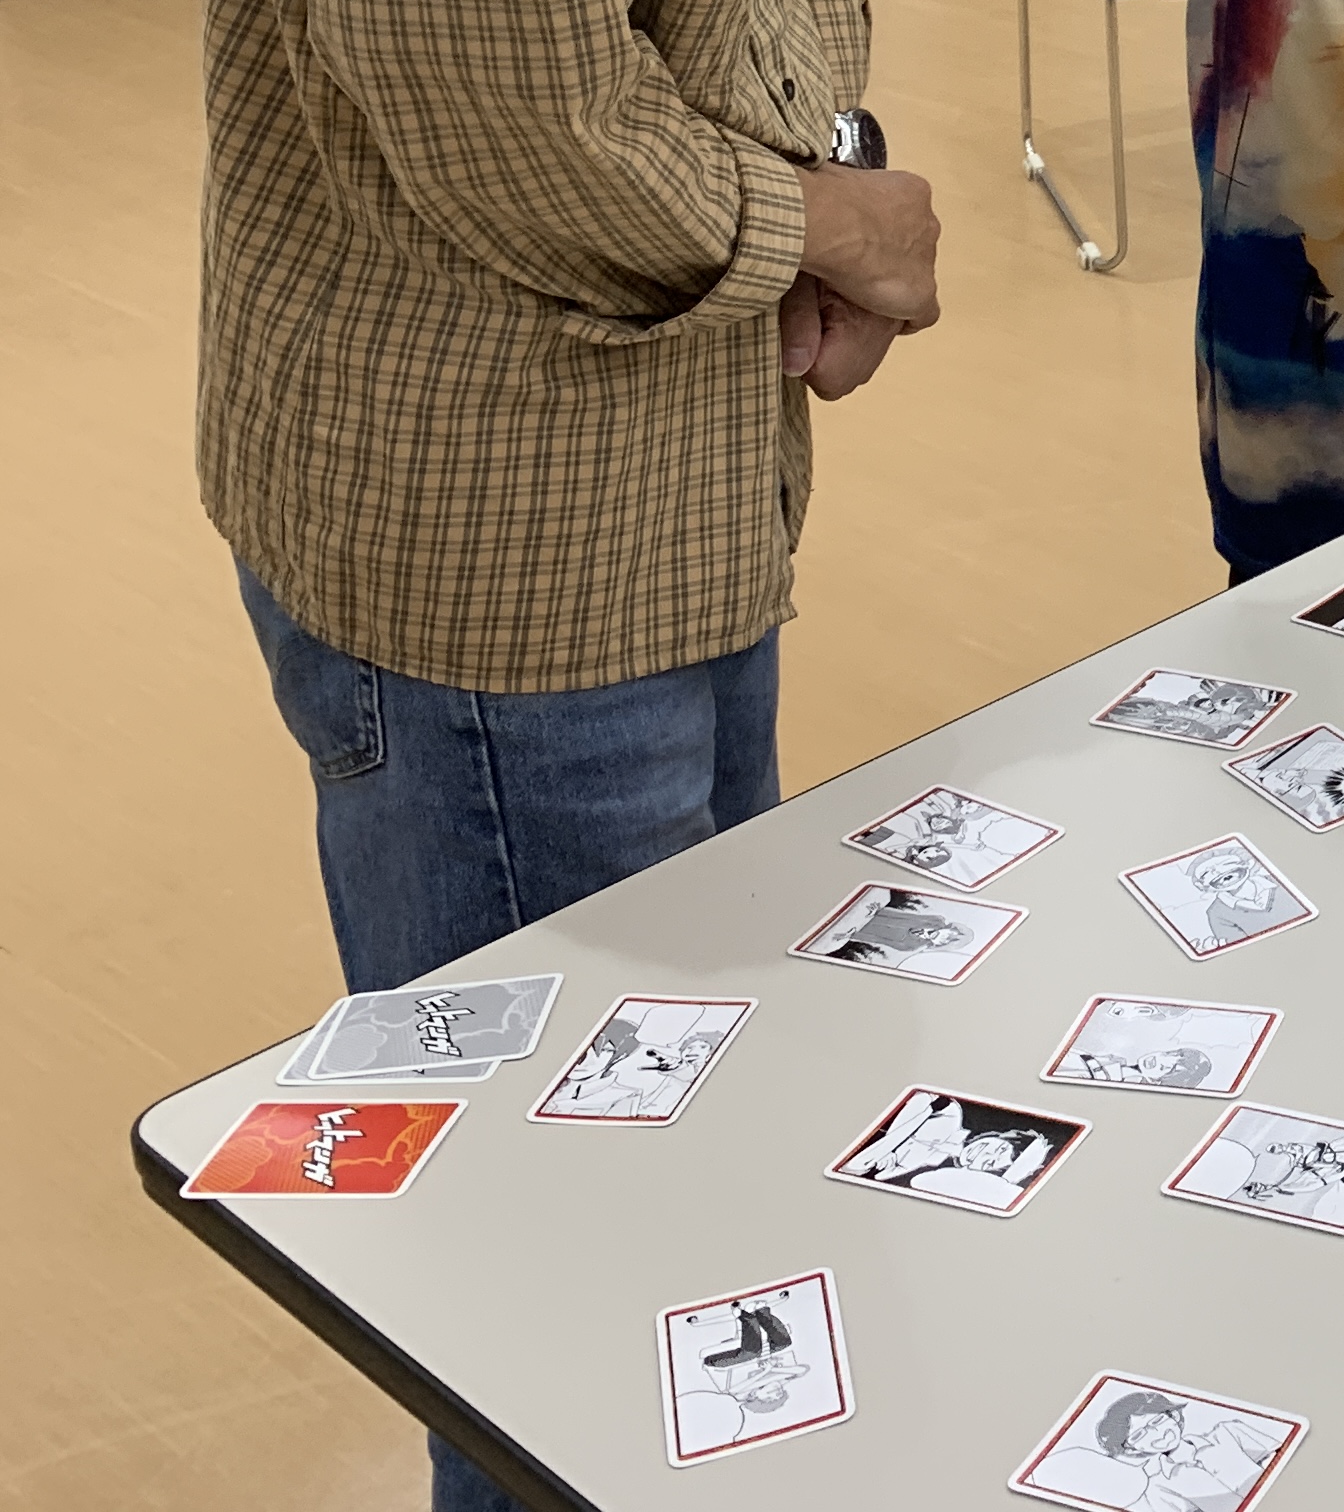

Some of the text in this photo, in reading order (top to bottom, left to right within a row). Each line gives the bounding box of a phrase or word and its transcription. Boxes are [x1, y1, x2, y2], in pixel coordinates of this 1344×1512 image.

[301, 1106, 367, 1190] ヒットマンガ
